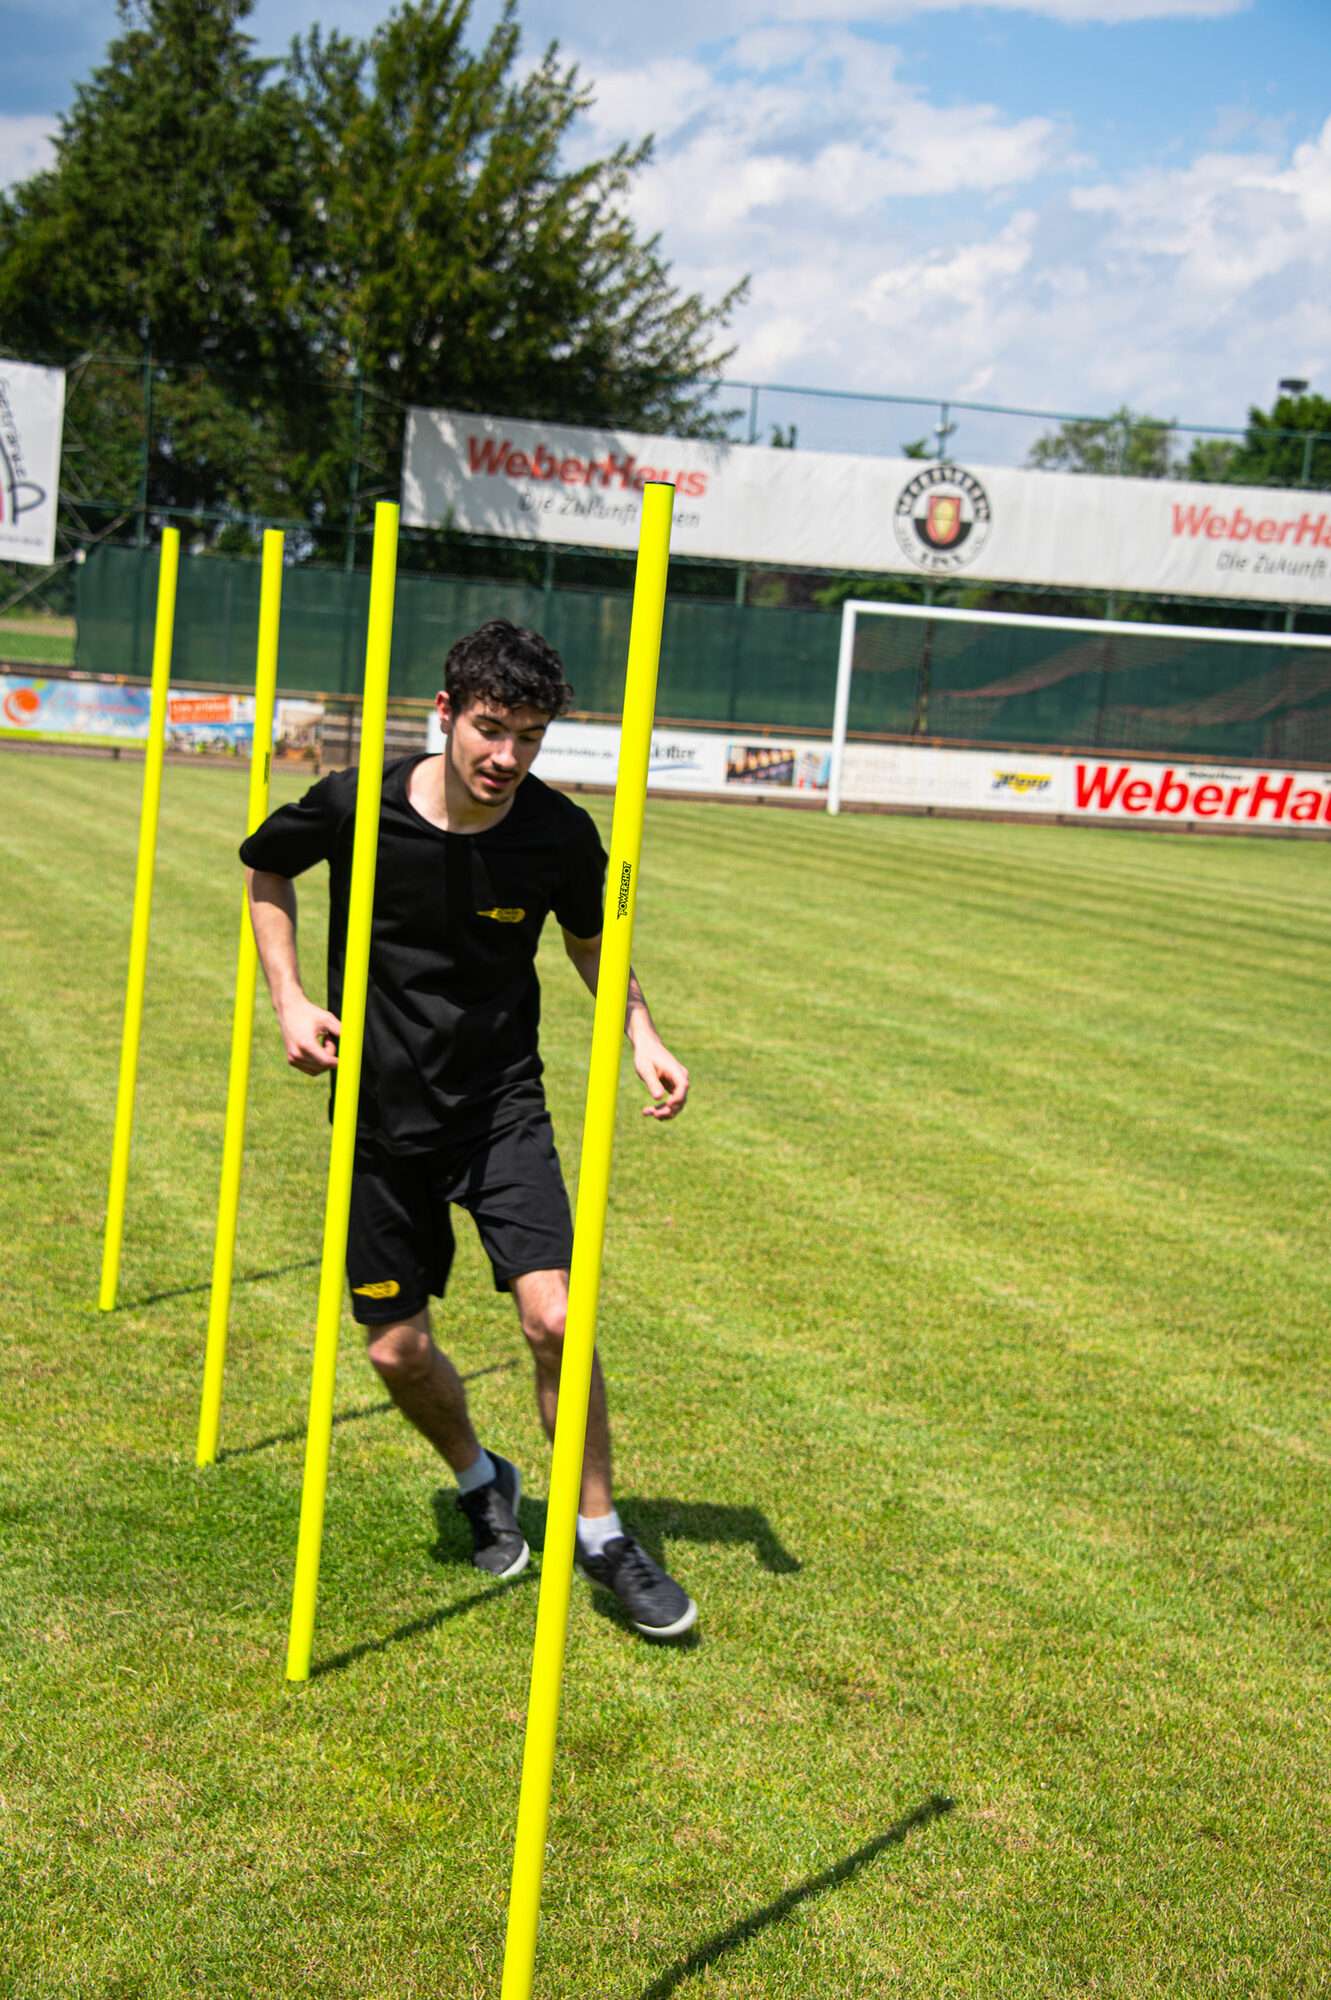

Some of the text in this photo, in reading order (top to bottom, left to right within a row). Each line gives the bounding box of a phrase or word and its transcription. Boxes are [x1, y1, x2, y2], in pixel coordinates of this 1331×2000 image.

[1217, 551, 1327, 580] Die Zukunft
[1074, 762, 1331, 822] WeberHa
[616, 861, 632, 920] POWERSHOT
